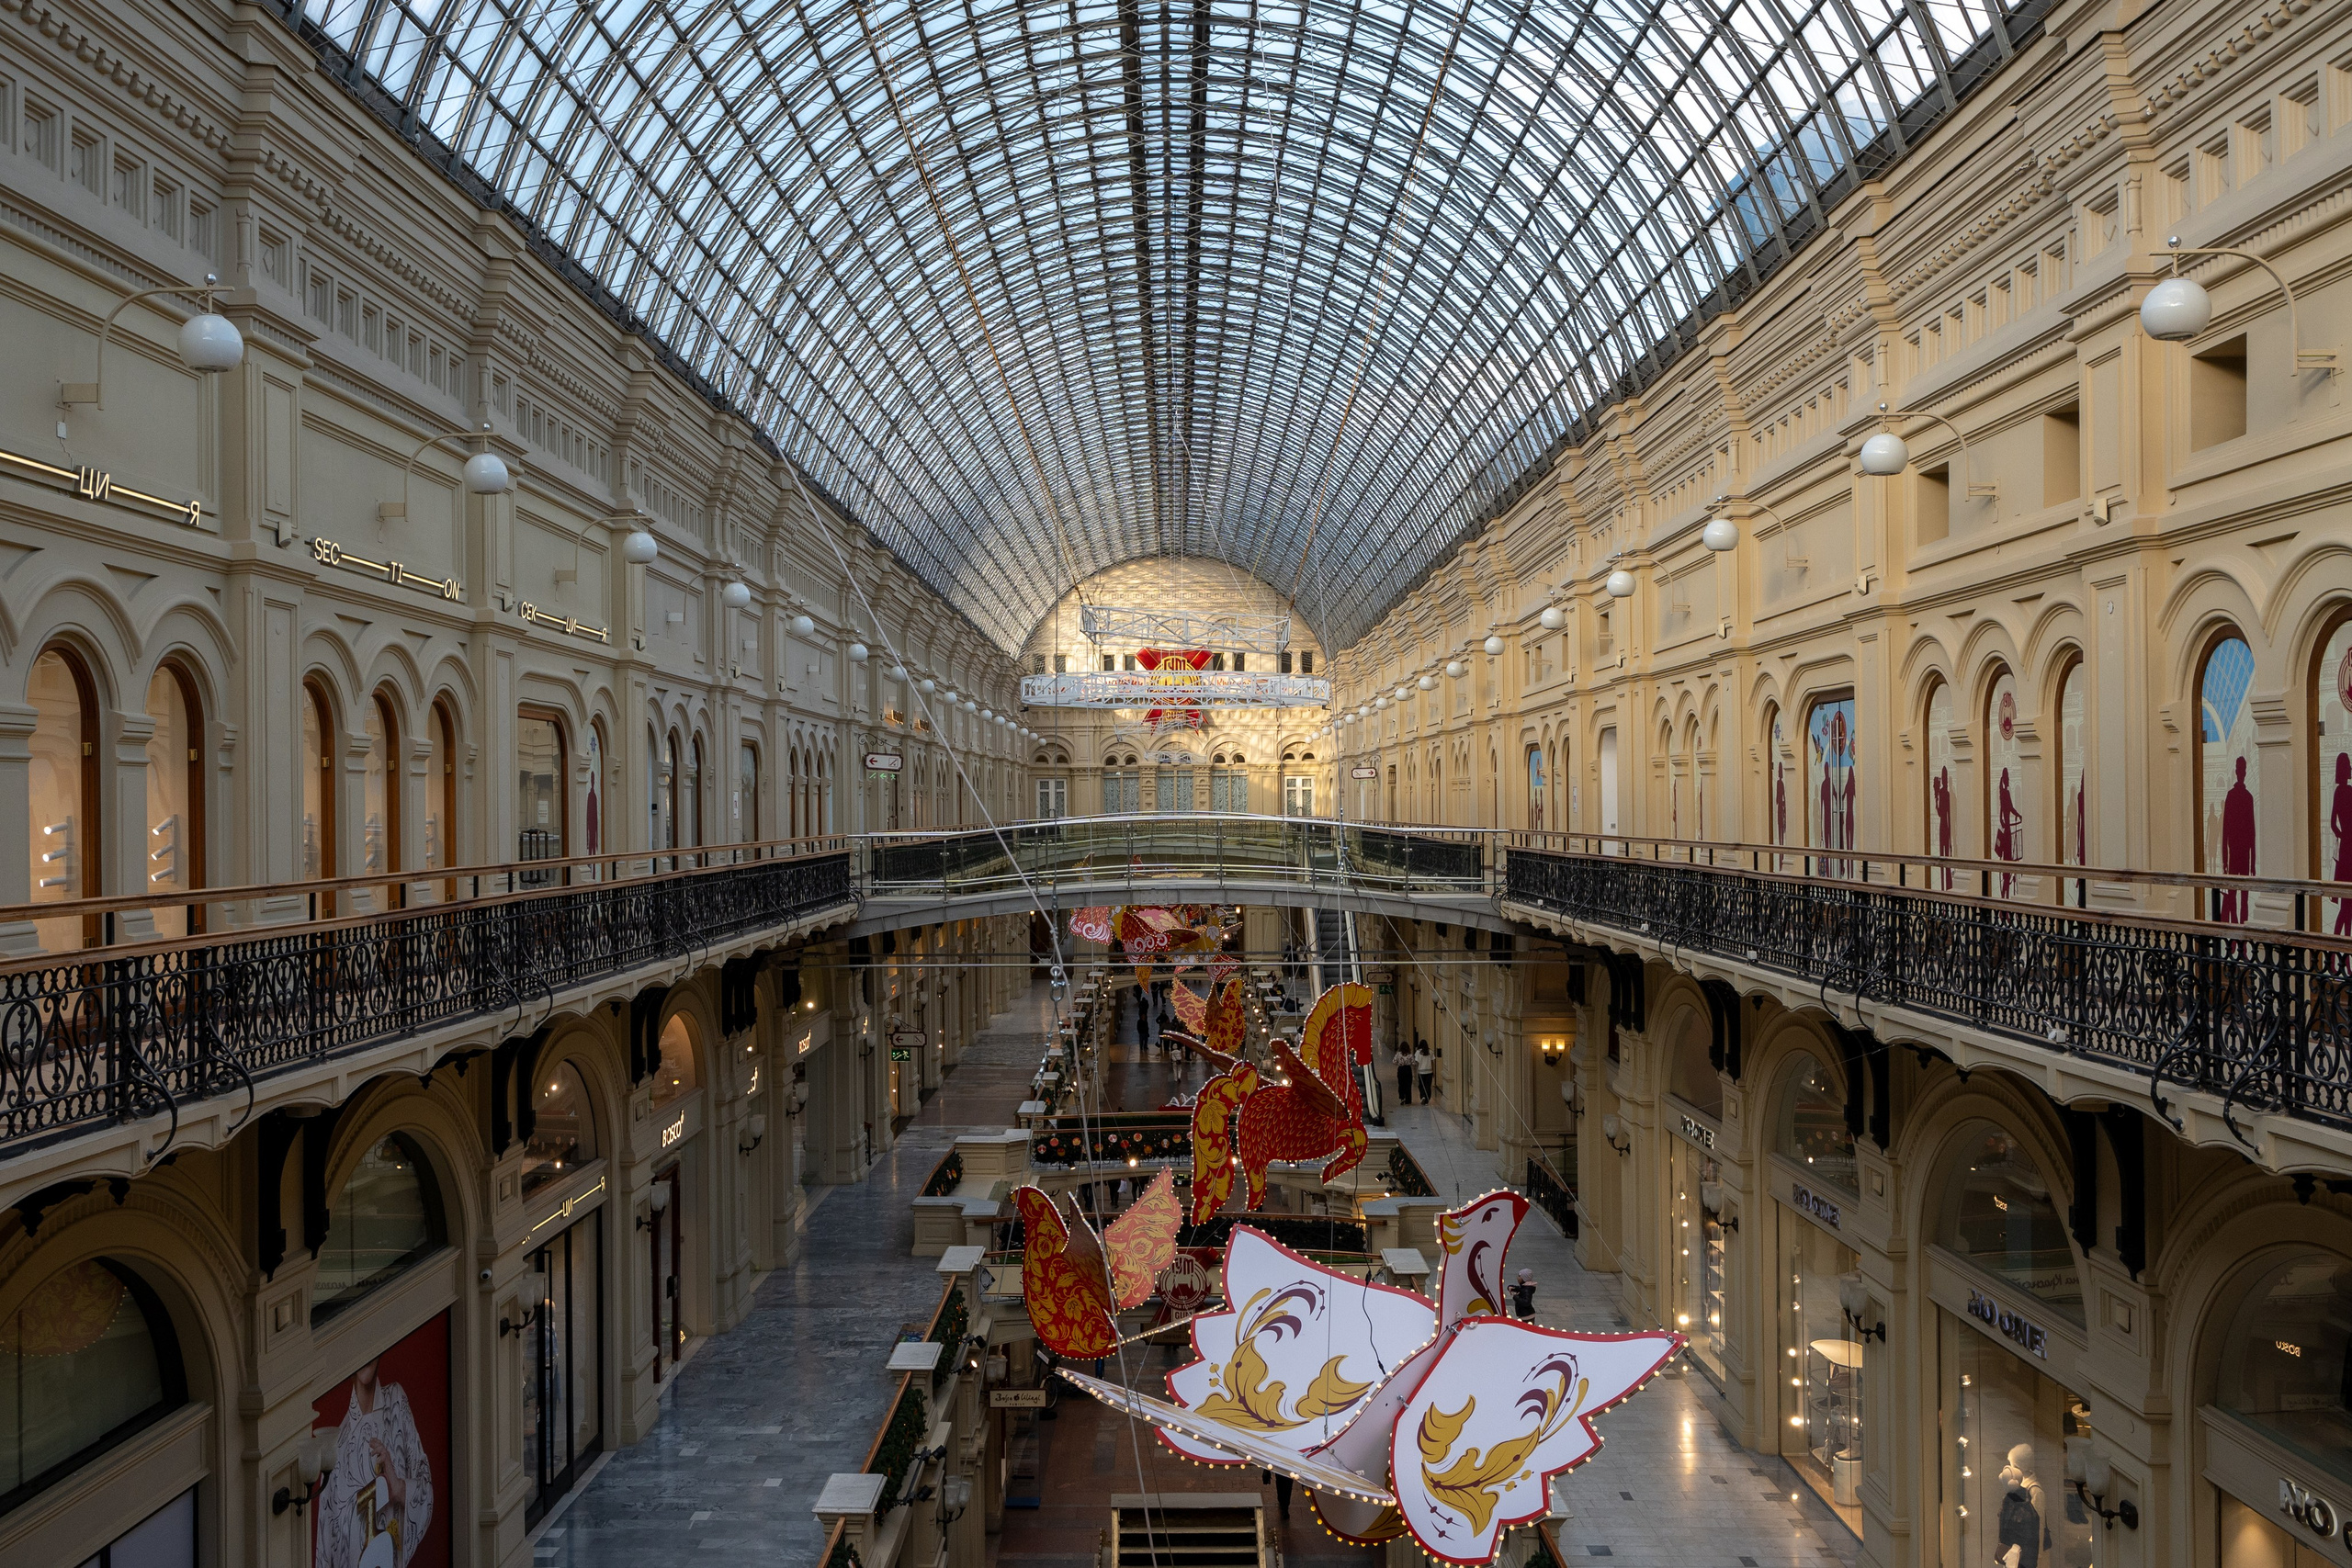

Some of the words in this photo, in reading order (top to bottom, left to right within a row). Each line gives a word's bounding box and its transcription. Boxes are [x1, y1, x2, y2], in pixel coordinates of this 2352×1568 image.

[313, 536, 341, 565] SEC
[444, 578, 461, 600] ON
[520, 600, 537, 622] СЕК
[662, 1120, 682, 1148] BOSCO
[1998, 1310, 2048, 1360] ONE
[2278, 1477, 2338, 1537] NO
